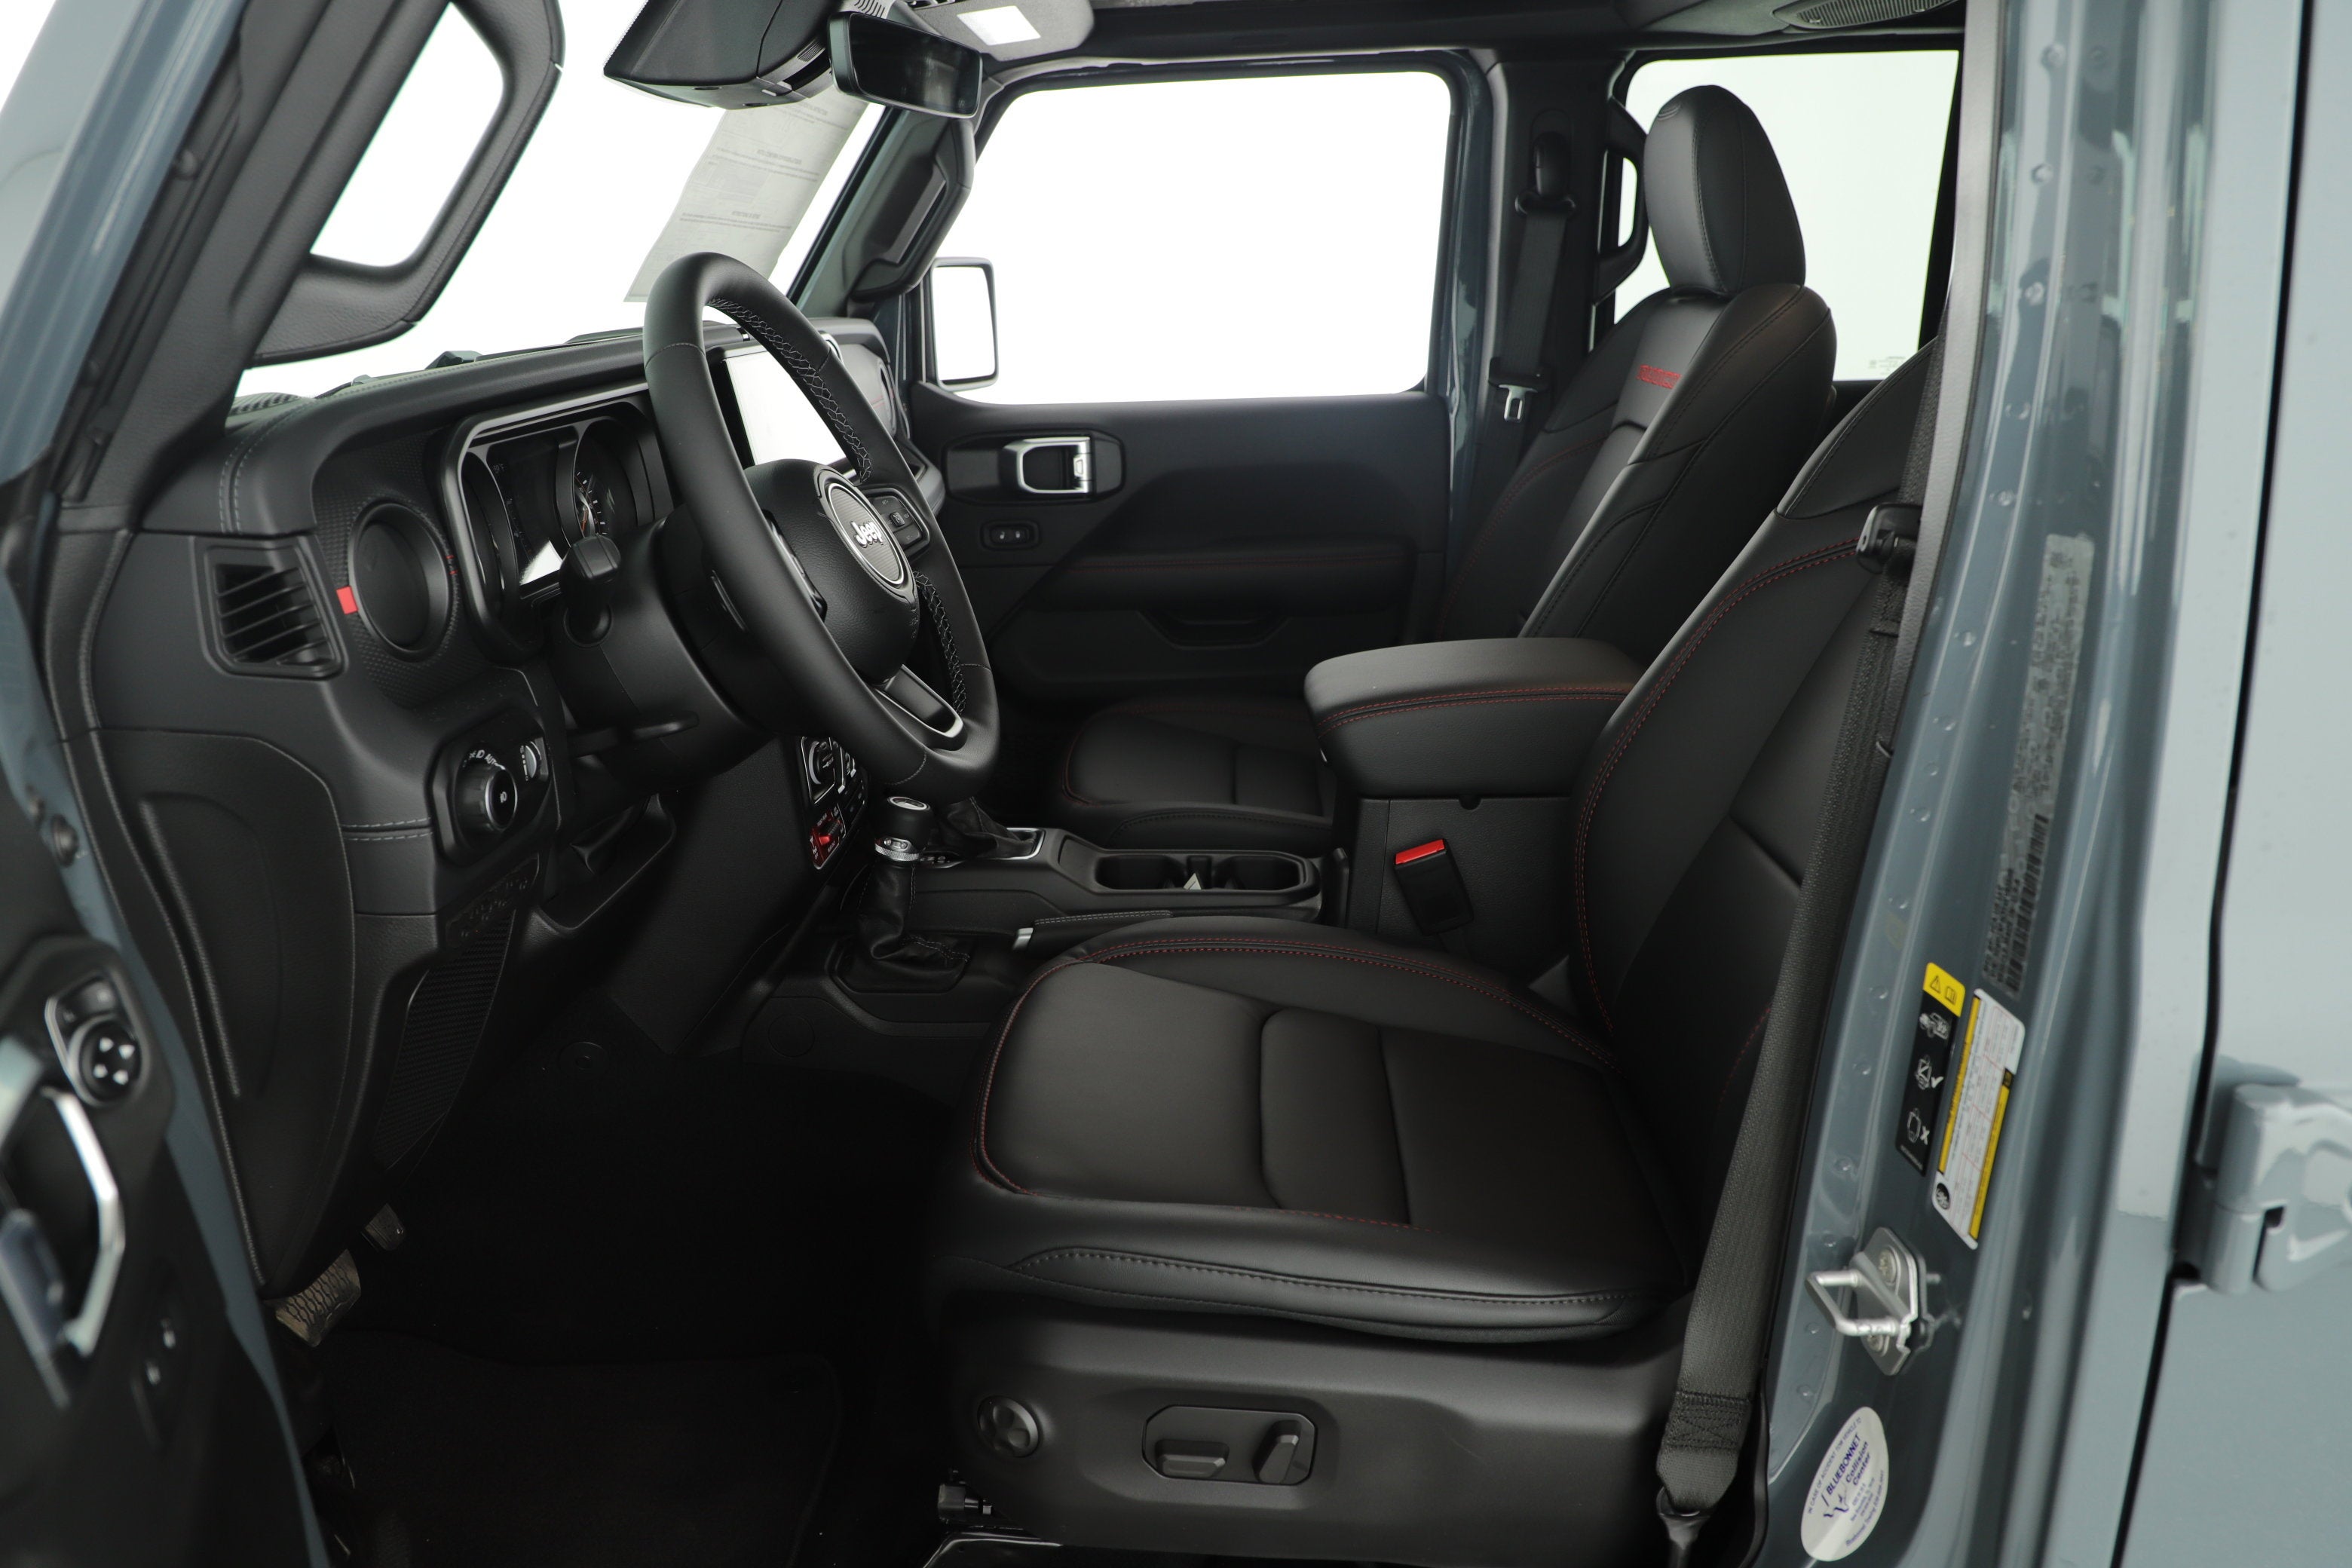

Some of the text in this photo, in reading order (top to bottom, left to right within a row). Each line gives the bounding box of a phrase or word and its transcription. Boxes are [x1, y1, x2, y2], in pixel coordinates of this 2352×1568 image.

[850, 521, 884, 547] Jeep
[1827, 1434, 1861, 1495] BLUEBONNET
[1845, 1441, 1869, 1483] Collision
[1852, 1453, 1870, 1486] Center
